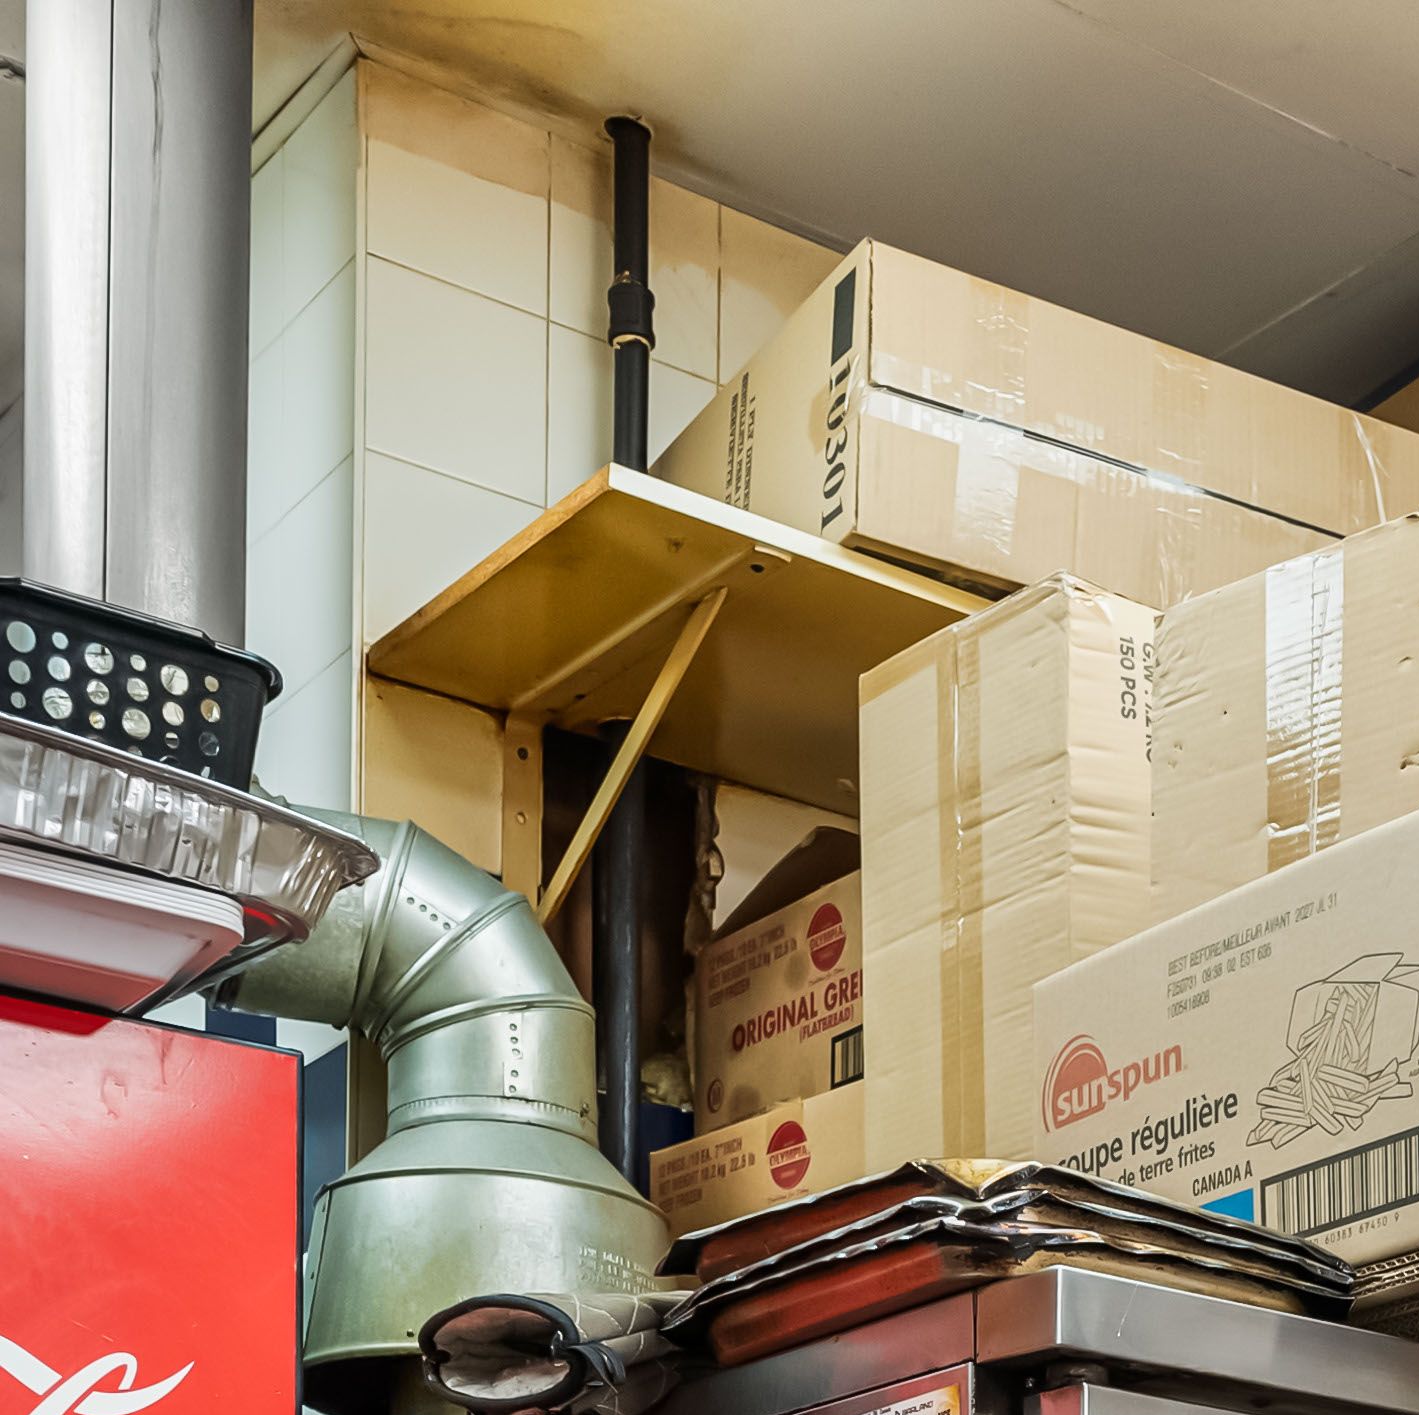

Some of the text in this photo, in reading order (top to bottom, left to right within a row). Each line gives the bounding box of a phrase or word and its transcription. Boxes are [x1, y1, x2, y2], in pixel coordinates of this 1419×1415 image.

[1119, 636, 1137, 720] 150 PCS
[1167, 954, 1189, 977] BEST
[1263, 911, 1291, 935] AVANT
[731, 990, 818, 1053] ORIGINAL
[1057, 1043, 1183, 1122] sunspun
[769, 1140, 811, 1169] OLYMPIA
[1131, 1092, 1239, 1156] régulière
[1138, 1155, 1174, 1183] terre
[1177, 1140, 1216, 1169] frites
[1192, 1159, 1254, 1197] CANADA A
